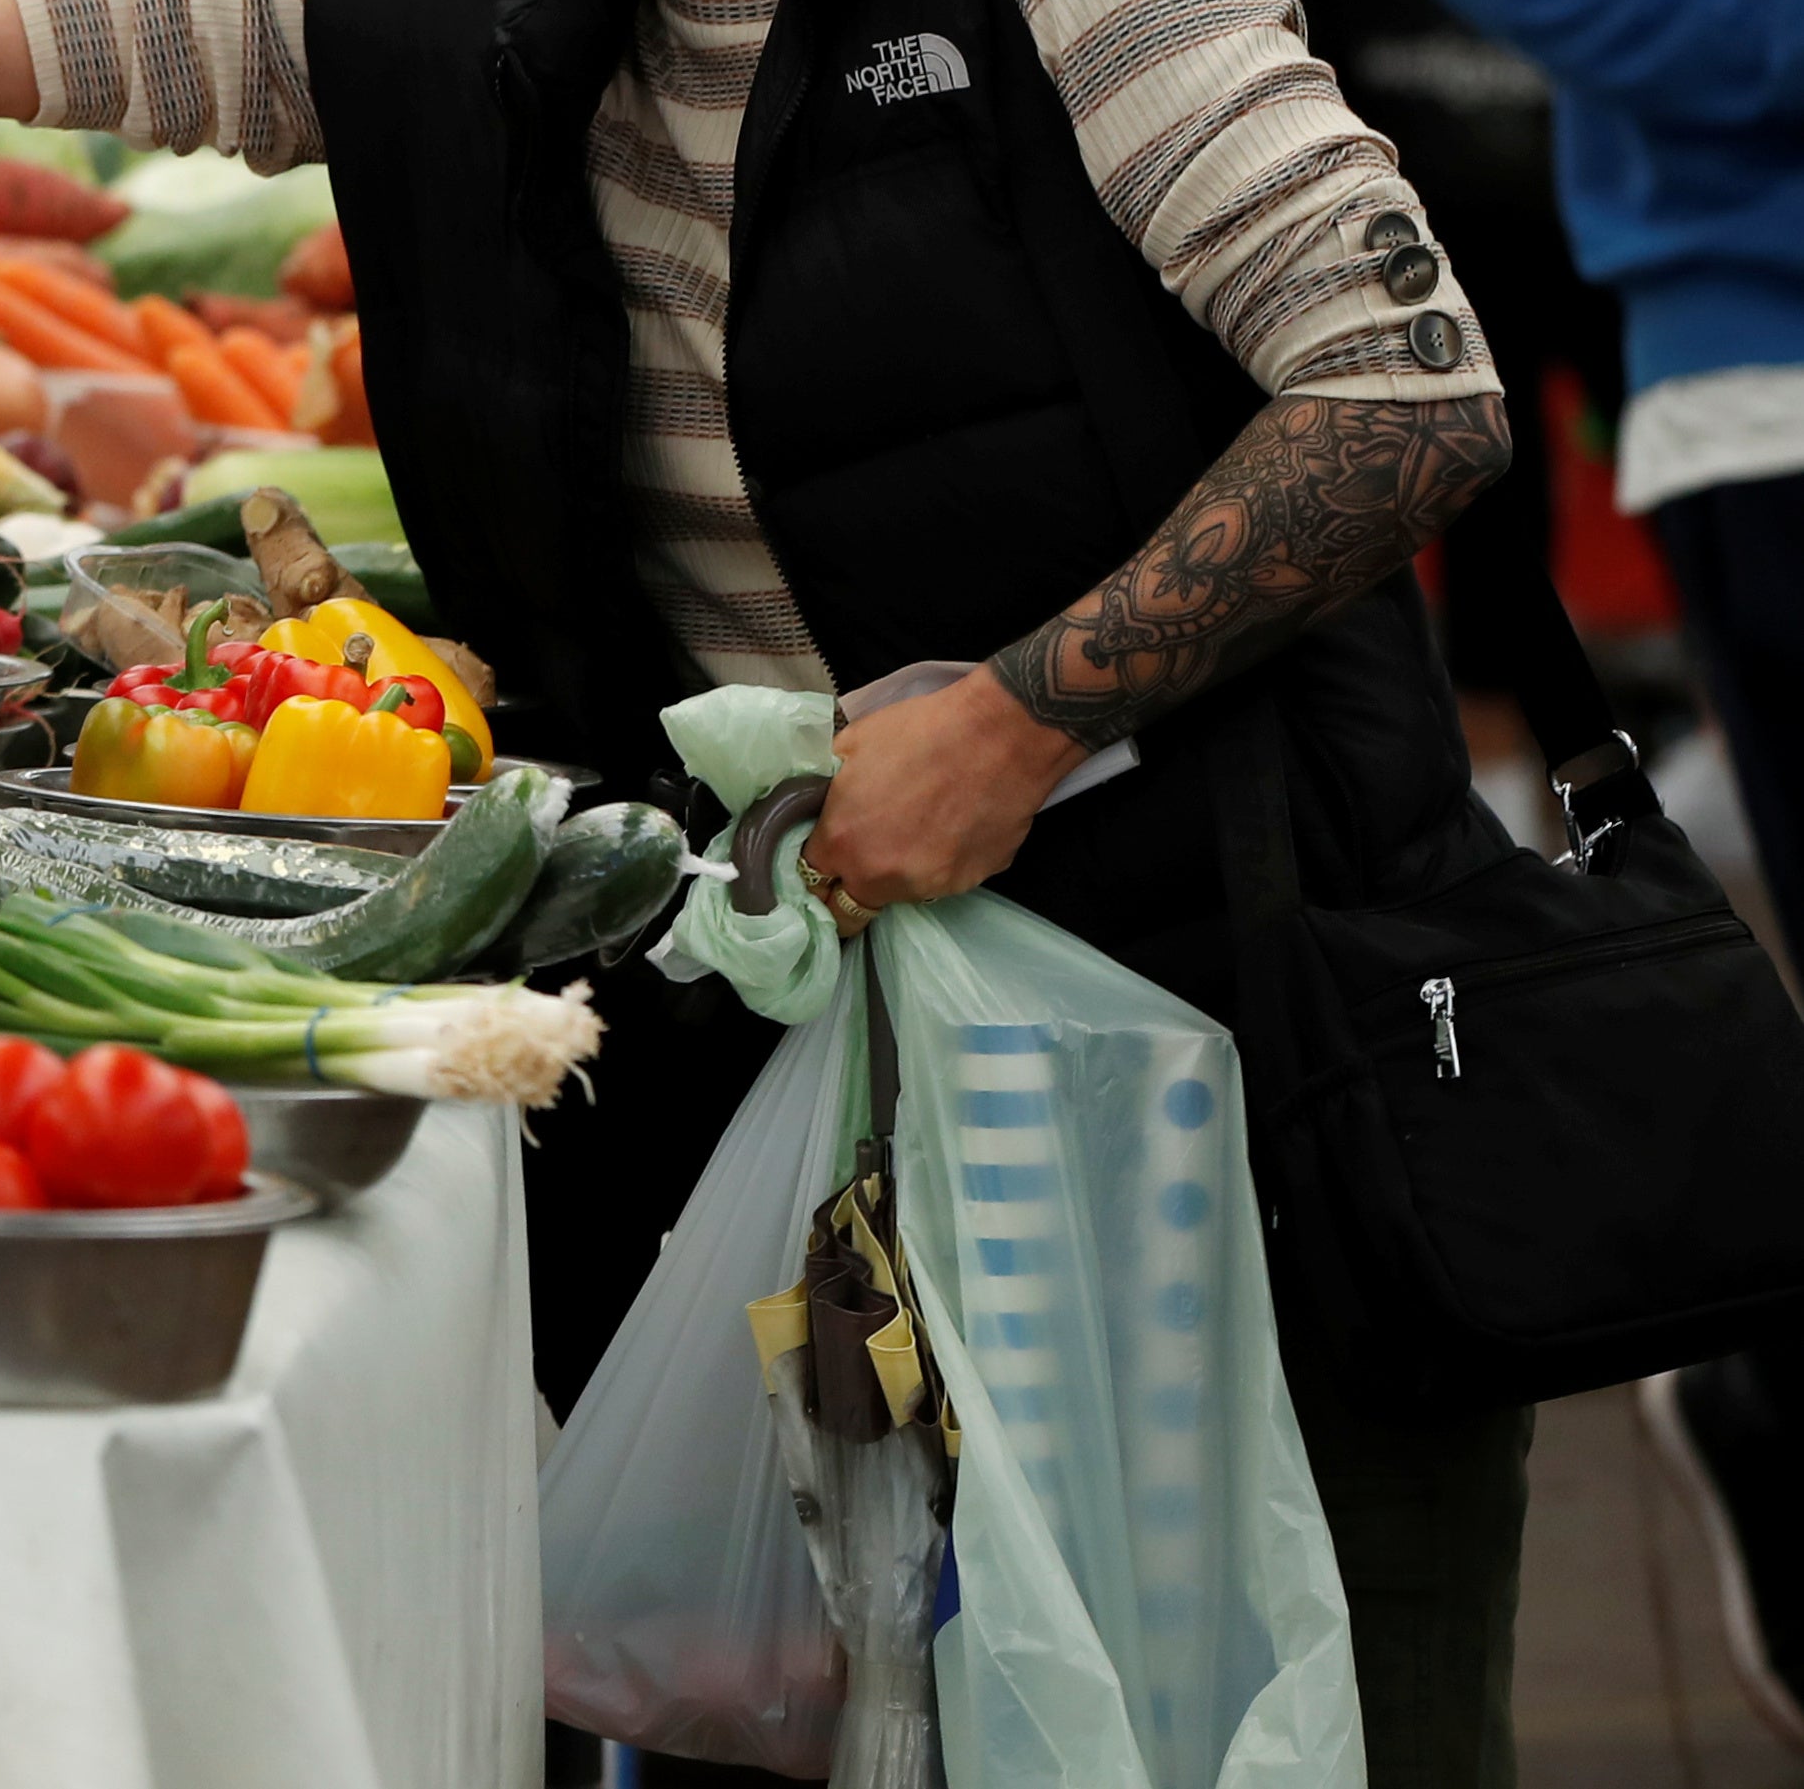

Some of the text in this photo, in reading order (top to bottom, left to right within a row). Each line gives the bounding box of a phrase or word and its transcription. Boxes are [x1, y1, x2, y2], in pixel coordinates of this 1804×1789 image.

[872, 35, 919, 62] THE
[845, 55, 924, 93] NORTH
[871, 75, 929, 106] FACE
